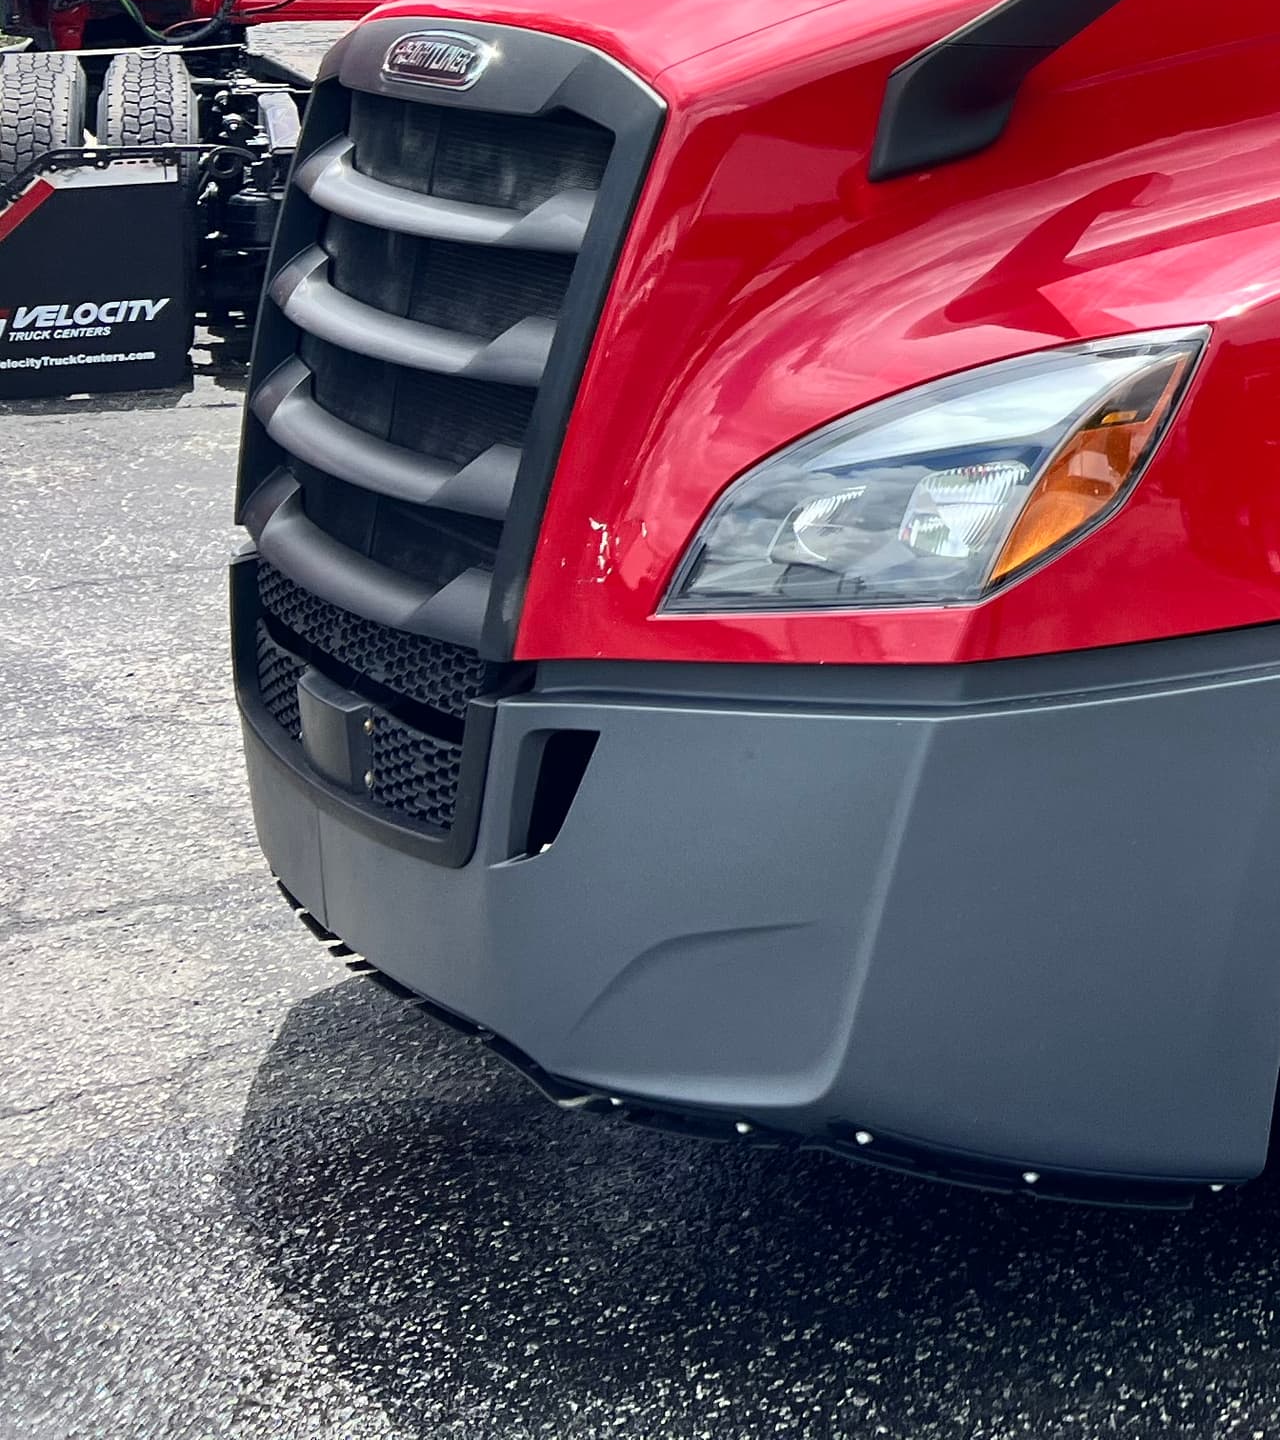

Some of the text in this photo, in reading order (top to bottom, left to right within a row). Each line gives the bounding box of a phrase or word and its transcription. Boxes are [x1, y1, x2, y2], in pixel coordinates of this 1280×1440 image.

[12, 297, 171, 329] VELOCITY
[8, 326, 111, 343] TRUCK CENTERS
